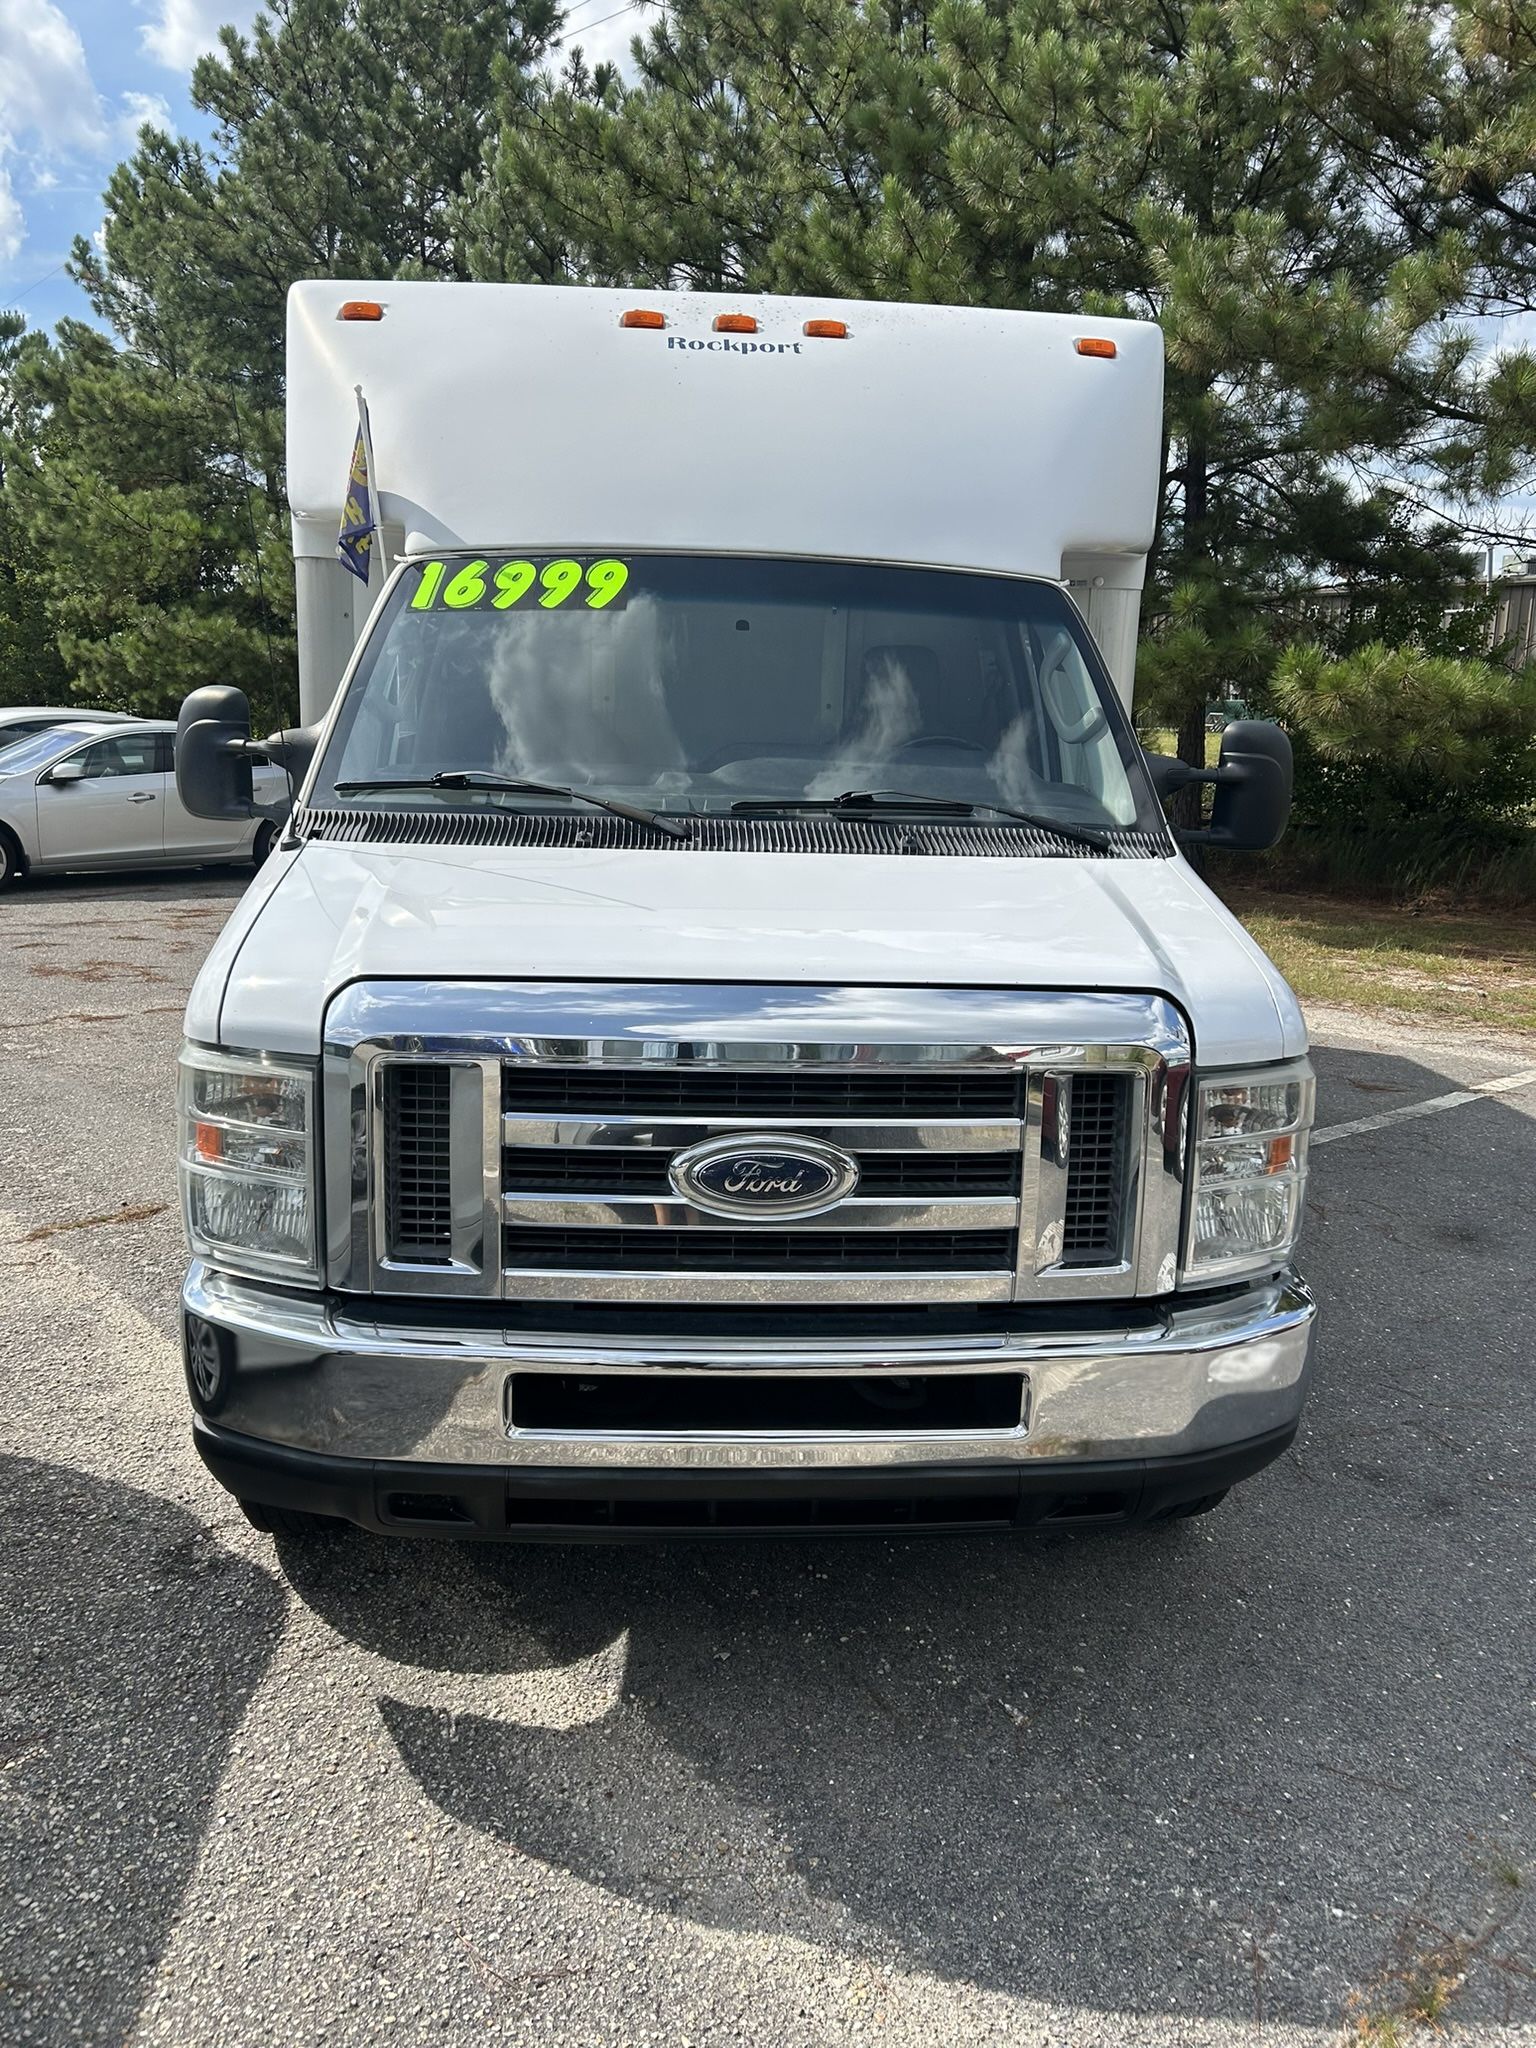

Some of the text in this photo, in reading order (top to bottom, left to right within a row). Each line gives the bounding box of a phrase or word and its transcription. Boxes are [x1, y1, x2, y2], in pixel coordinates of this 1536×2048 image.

[667, 336, 803, 354] Rockport
[410, 559, 629, 610] 16999
[724, 1159, 805, 1193] Ford
